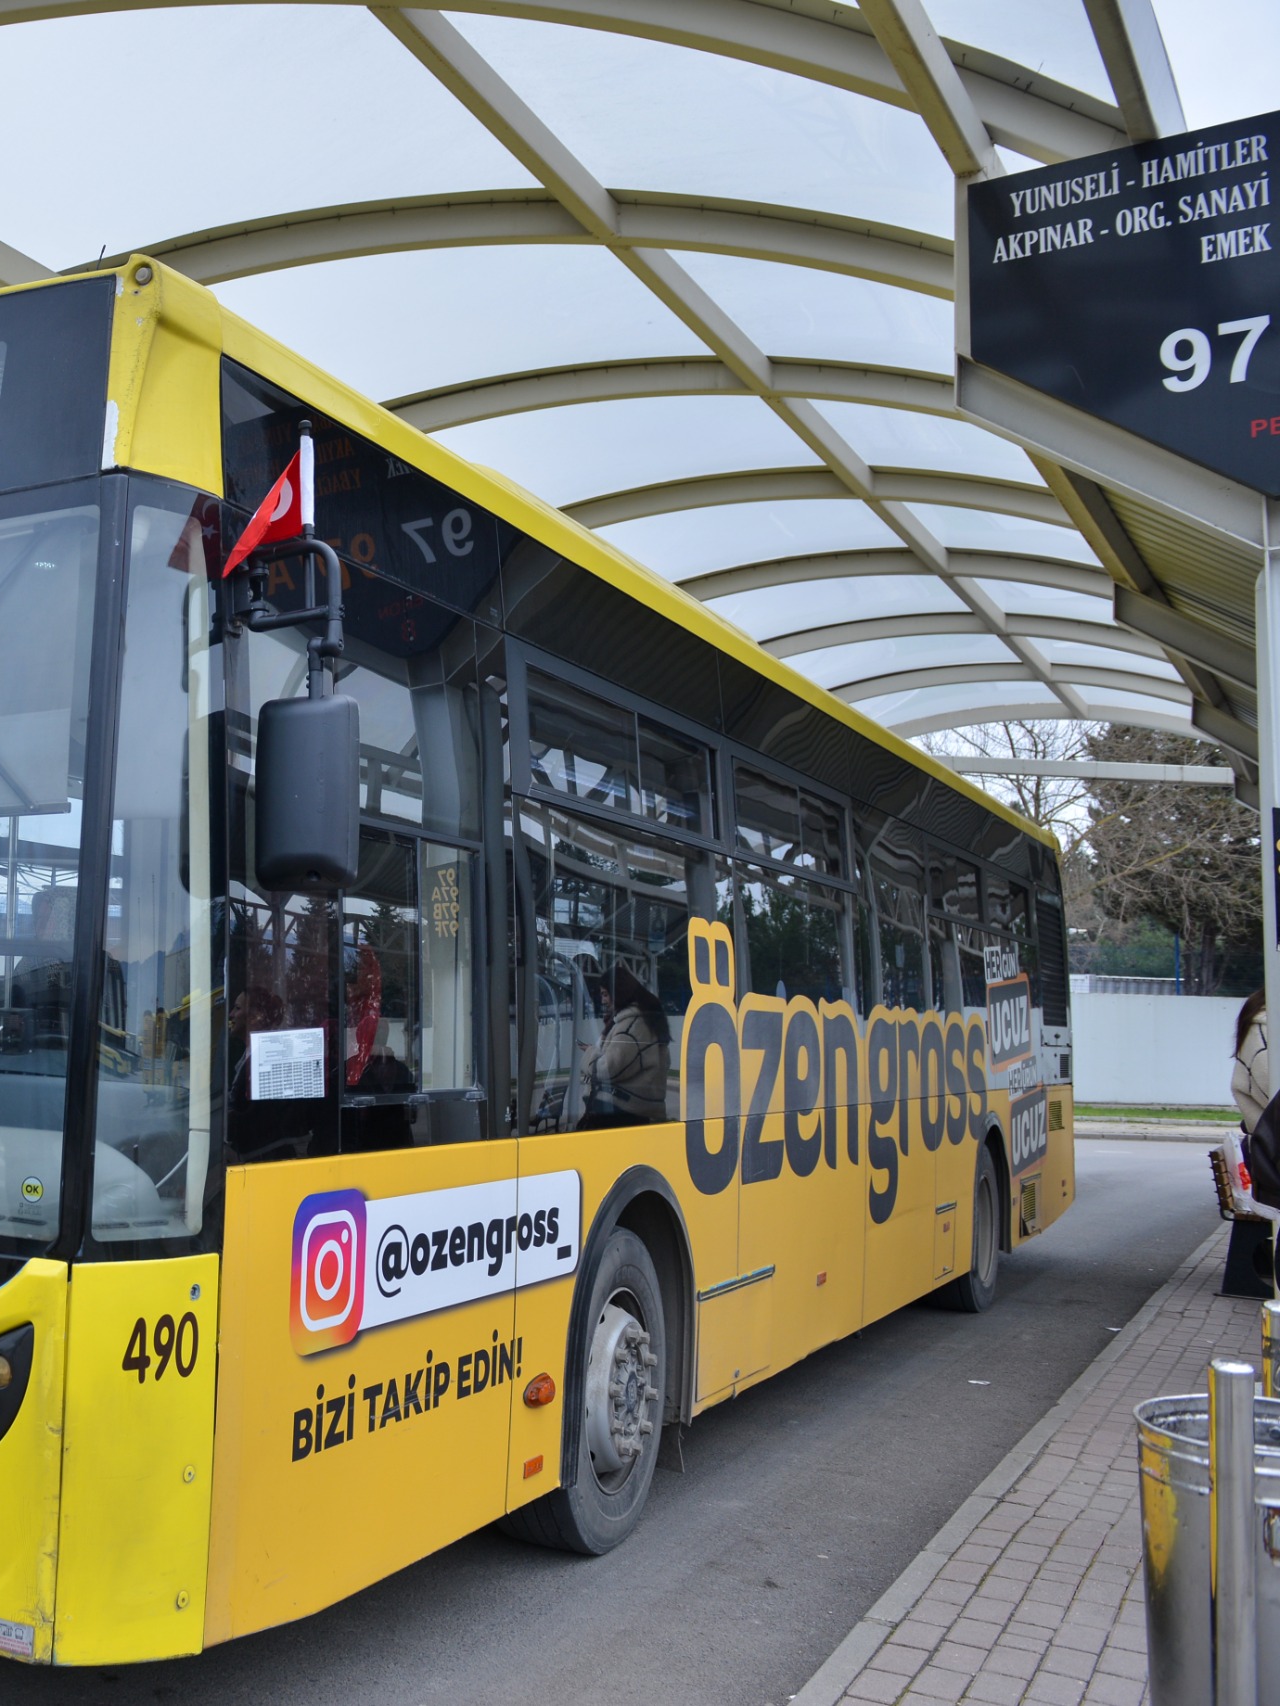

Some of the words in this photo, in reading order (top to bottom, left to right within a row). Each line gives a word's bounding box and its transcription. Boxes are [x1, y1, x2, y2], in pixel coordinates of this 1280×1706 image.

[1009, 162, 1120, 218] YUNUSELİ
[1141, 134, 1269, 188] HAMİTLER
[992, 218, 1095, 264] AKPINAR
[1116, 202, 1172, 237] ORG.
[1178, 171, 1271, 224] SANAYİ
[1200, 223, 1272, 264] EMEK
[1159, 314, 1270, 393] 97
[985, 950, 1001, 982] HER
[1001, 947, 1018, 979] GÜN
[990, 995, 1030, 1055] UCUZ
[1011, 1100, 1047, 1166] UCUZ
[25, 1184, 39, 1194] OK
[376, 1206, 573, 1298] @ozengross_
[121, 1311, 200, 1384] 490
[291, 1373, 357, 1463] BİZİ
[363, 1349, 451, 1433] TAKİP
[456, 1329, 524, 1401] EDİN!
